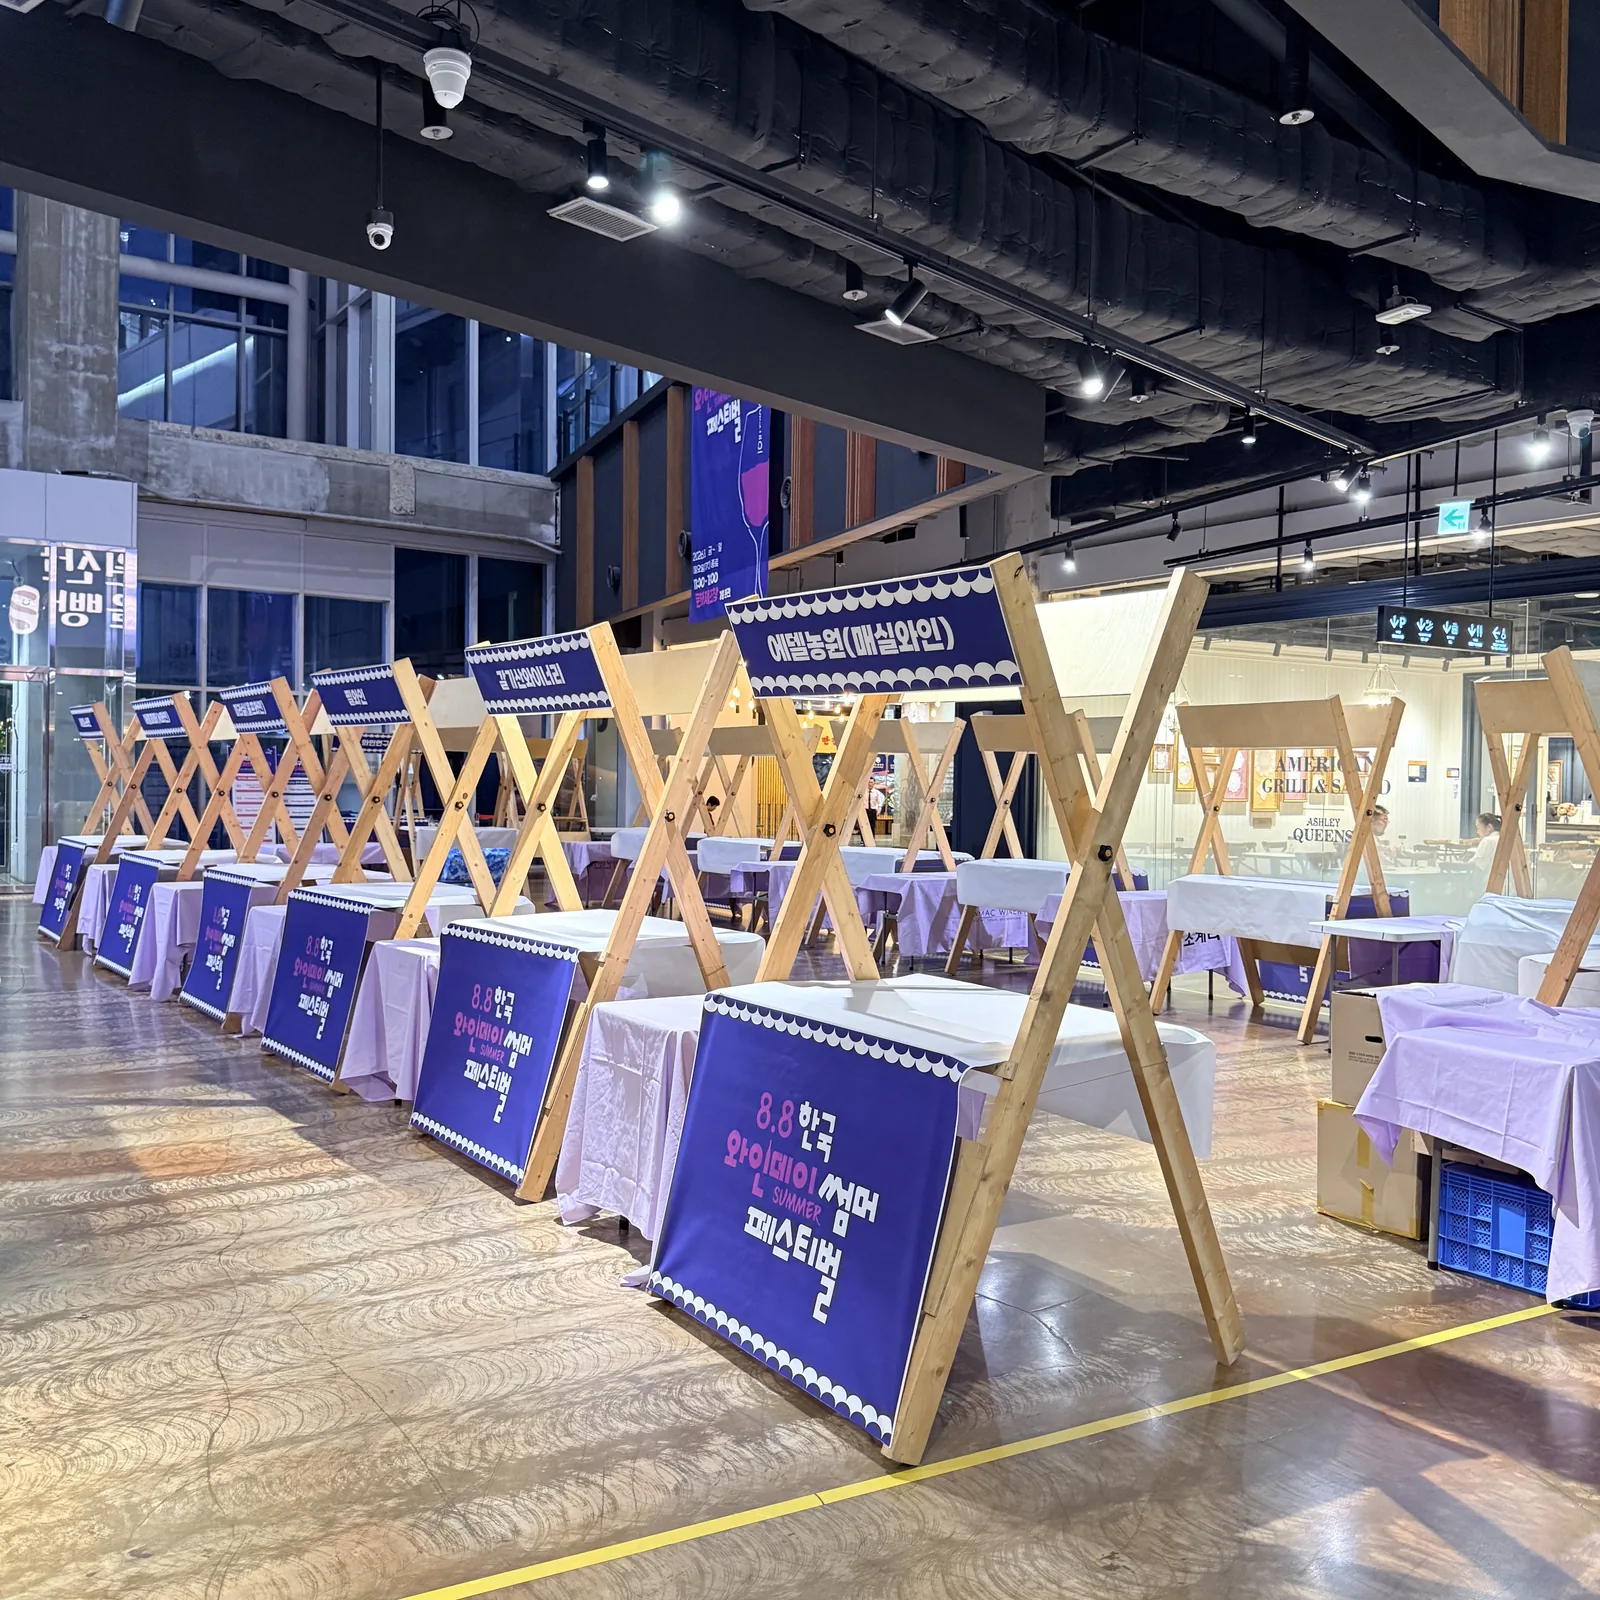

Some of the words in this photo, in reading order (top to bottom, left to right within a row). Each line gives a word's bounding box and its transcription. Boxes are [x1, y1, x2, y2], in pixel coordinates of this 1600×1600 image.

[767, 616, 955, 662] 에델농원(매실와인)
[496, 663, 566, 691] 갈기산와이너리
[1261, 778, 1311, 794] GRILL
[1293, 828, 1354, 844] QUEENS
[1306, 817, 1341, 828] ASHLEY
[471, 983, 492, 1012] 8.8
[494, 985, 515, 1024] 한국
[453, 1011, 504, 1053] 와인데이
[503, 1030, 533, 1069] 썸머
[480, 1043, 504, 1064] SUMMER
[464, 1058, 512, 1123] 페스티벌
[756, 1092, 794, 1138] 8.8
[799, 1101, 836, 1163] 한국
[723, 1129, 818, 1198] 와인데이
[818, 1173, 879, 1238] 썸머
[772, 1186, 823, 1226] SUMMER
[744, 1205, 842, 1325] 페스티벌
